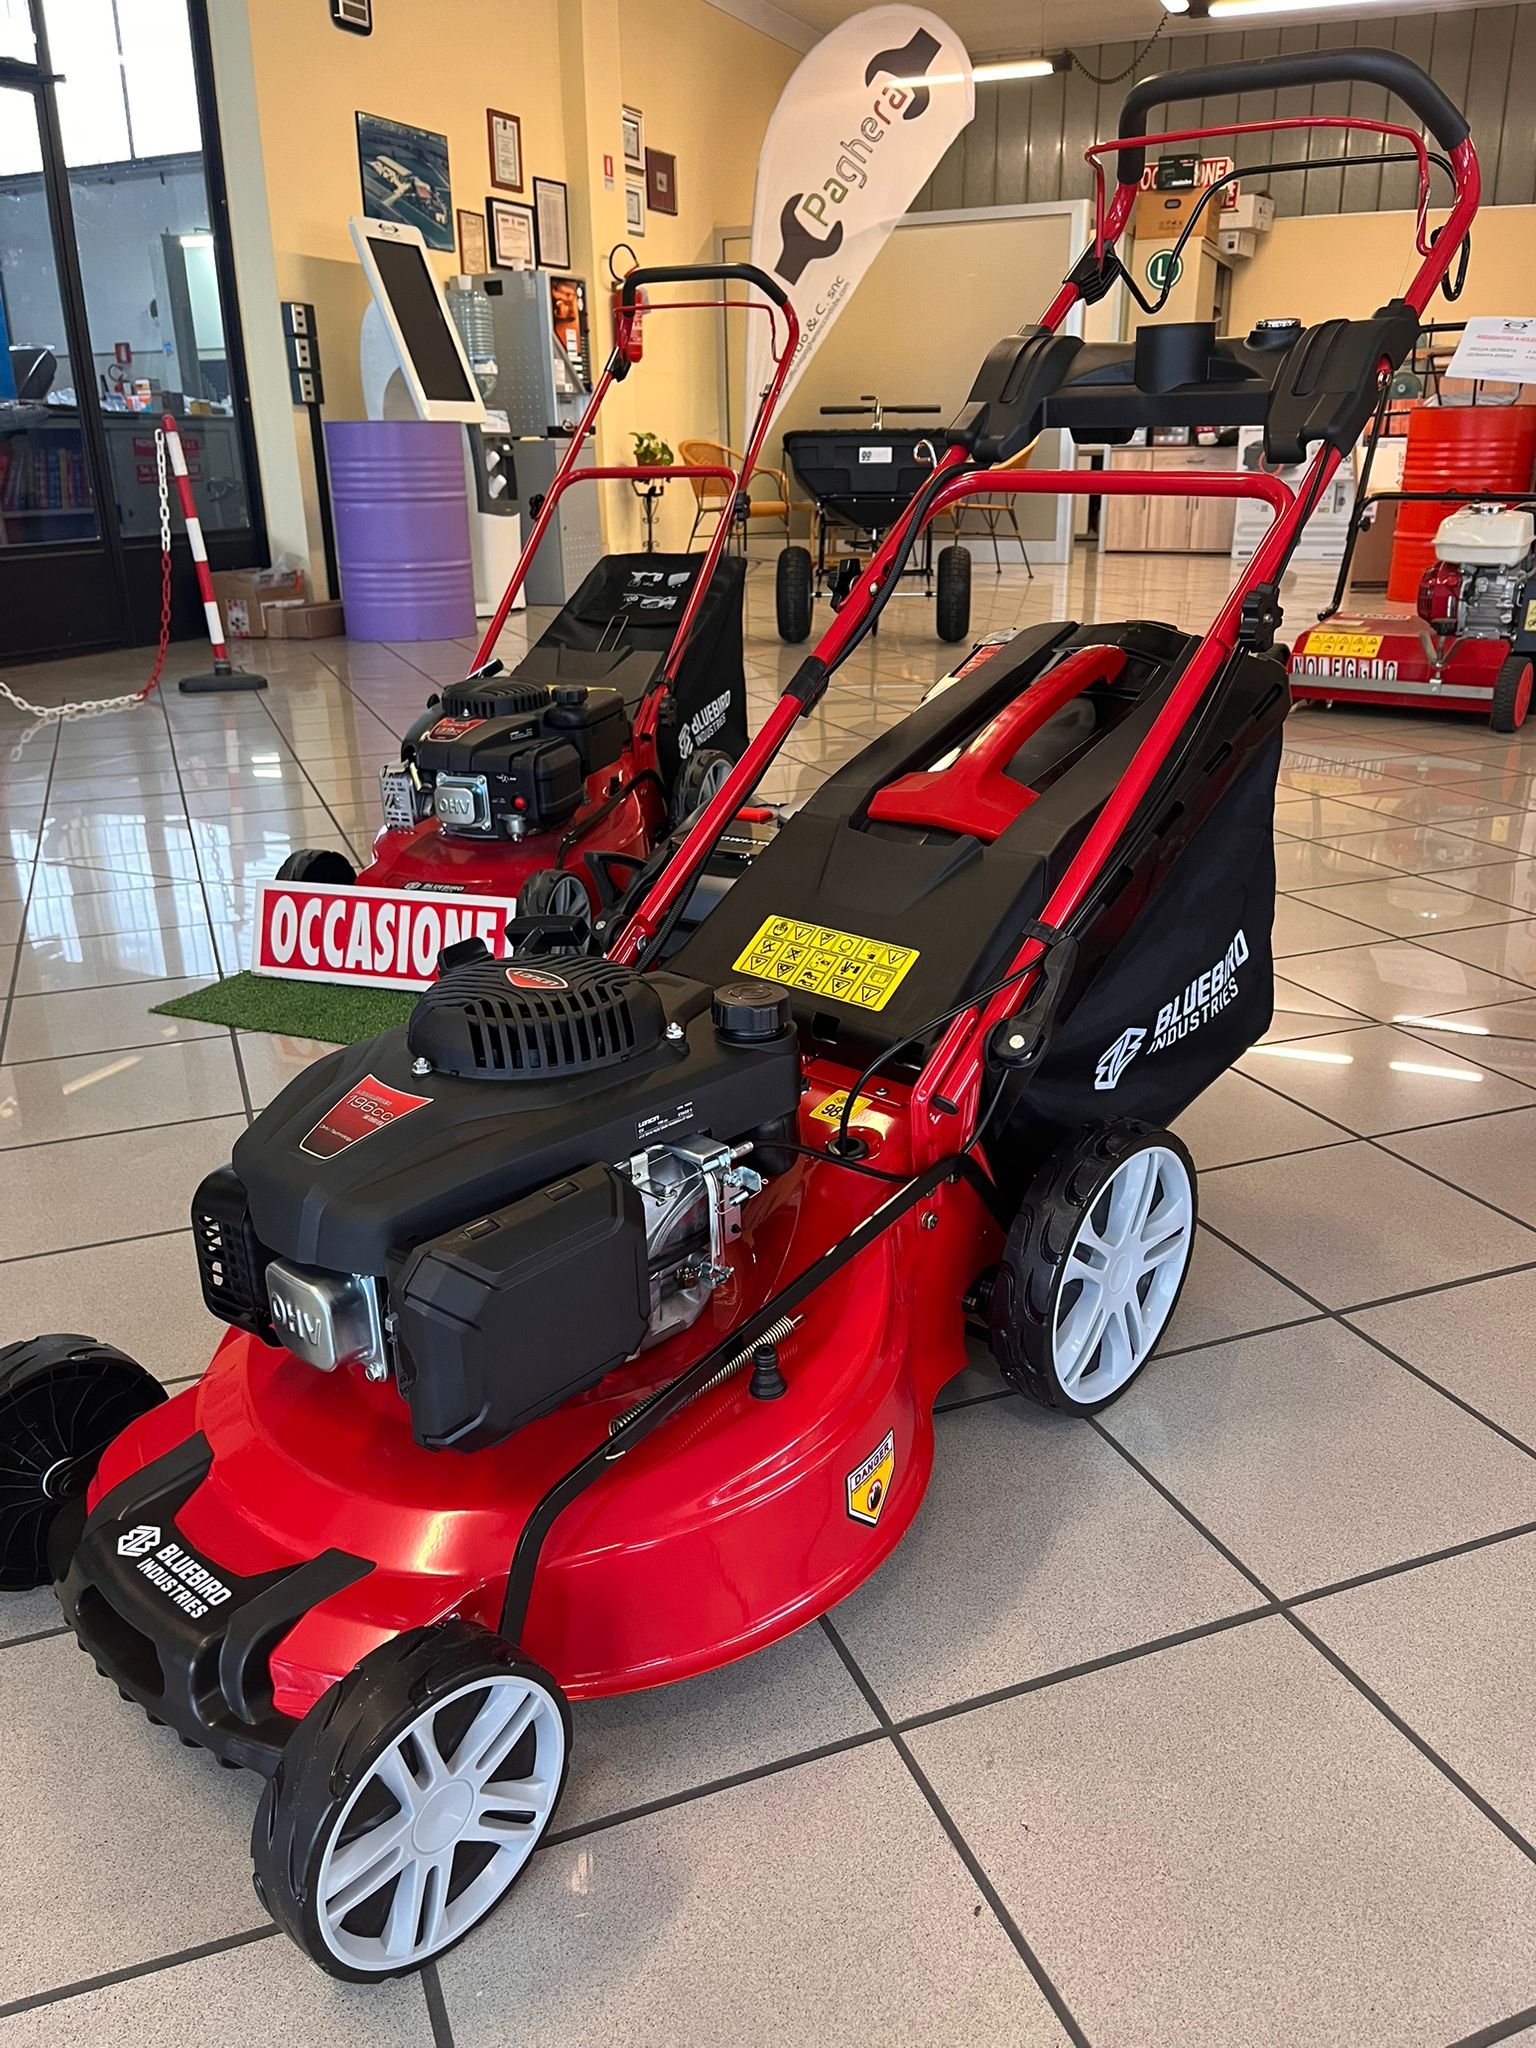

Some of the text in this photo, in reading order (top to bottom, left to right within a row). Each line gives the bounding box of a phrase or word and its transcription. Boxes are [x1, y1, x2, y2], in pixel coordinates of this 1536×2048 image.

[801, 84, 908, 227] Paghera
[806, 317, 818, 332] &
[827, 275, 845, 299] snc
[440, 798, 470, 814] OHV
[270, 894, 497, 977] OCCASIONE
[1153, 928, 1250, 1039] BLUEBIRD
[1146, 976, 1239, 1055] INDUSTRIES
[346, 1094, 395, 1121] 196cc
[820, 1103, 844, 1118] 98
[272, 1291, 322, 1346] OHV
[854, 1442, 890, 1486] DANGER
[136, 1557, 209, 1619] INDUSTRIES
[155, 1542, 233, 1607] BLUEBIRD
